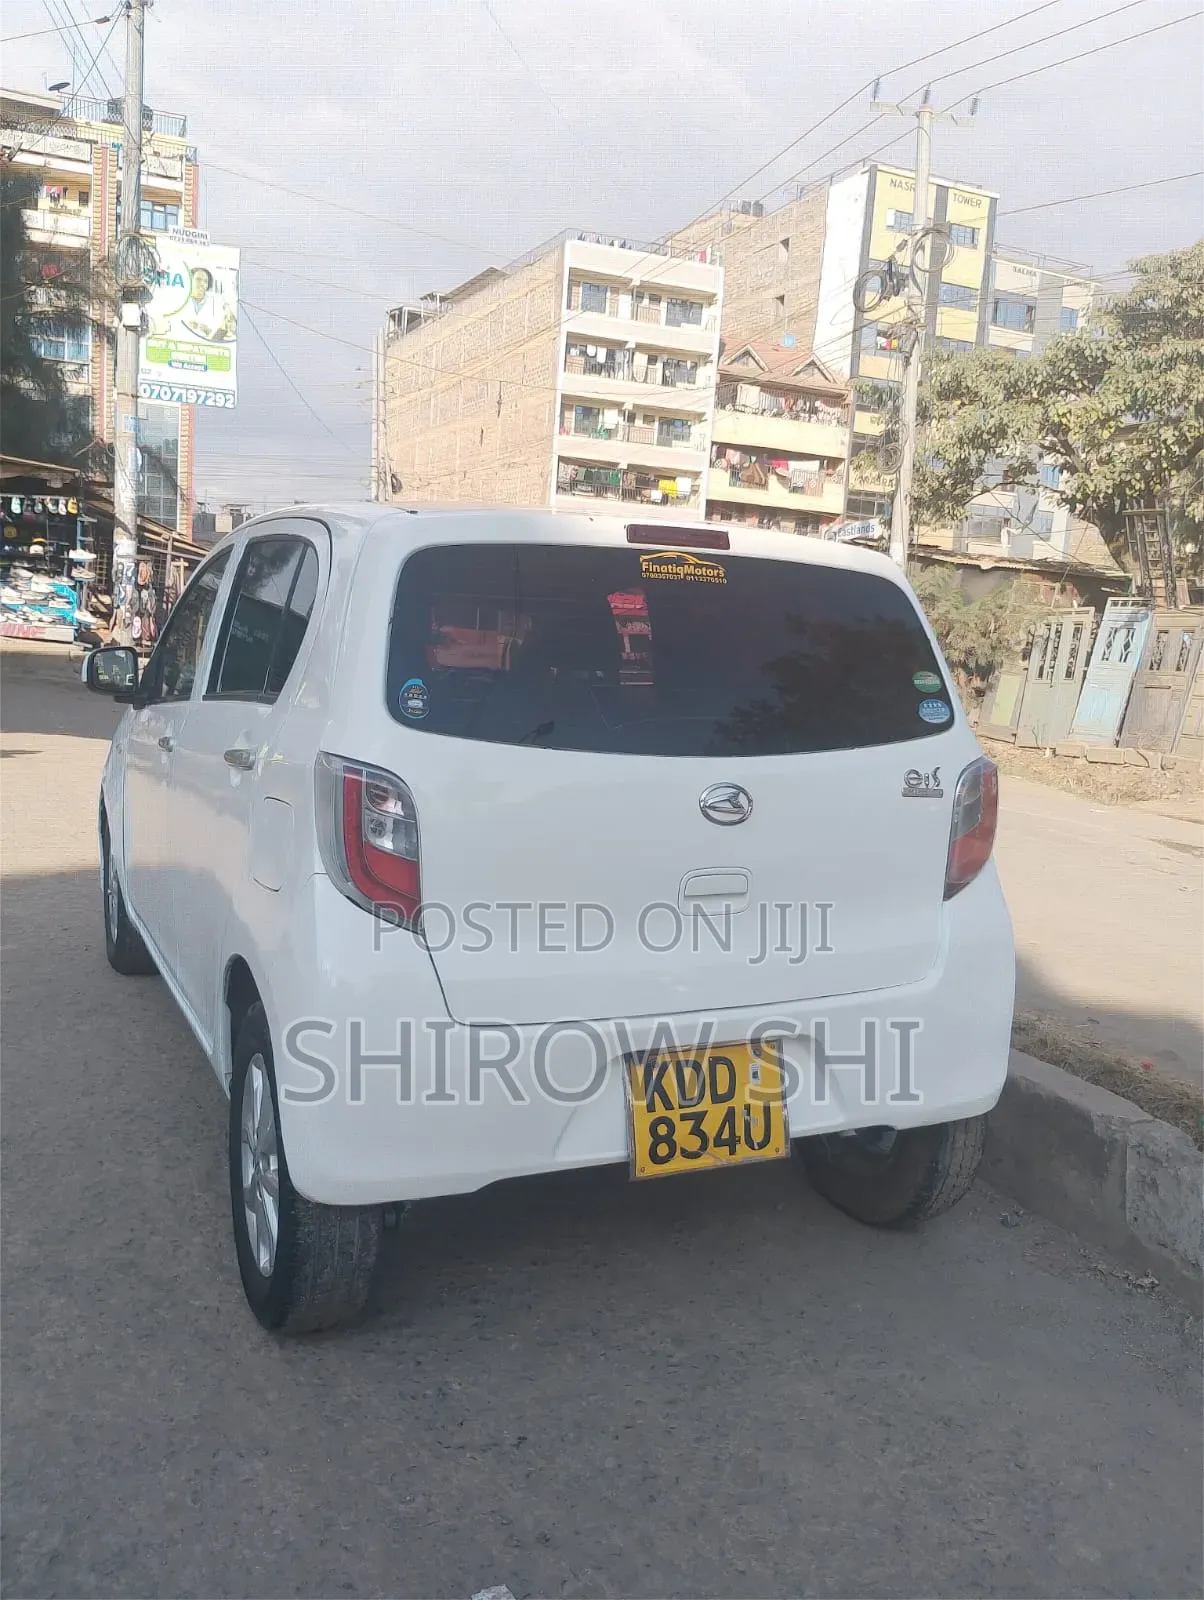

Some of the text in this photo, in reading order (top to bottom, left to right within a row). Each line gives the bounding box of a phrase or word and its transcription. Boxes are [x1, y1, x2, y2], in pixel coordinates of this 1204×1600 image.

[890, 178, 982, 208] NASR TOWER
[140, 383, 235, 409] 0707197292
[642, 561, 725, 579] FinatiqMotors
[643, 1056, 737, 1113] KDD
[649, 1101, 772, 1165] 834U
